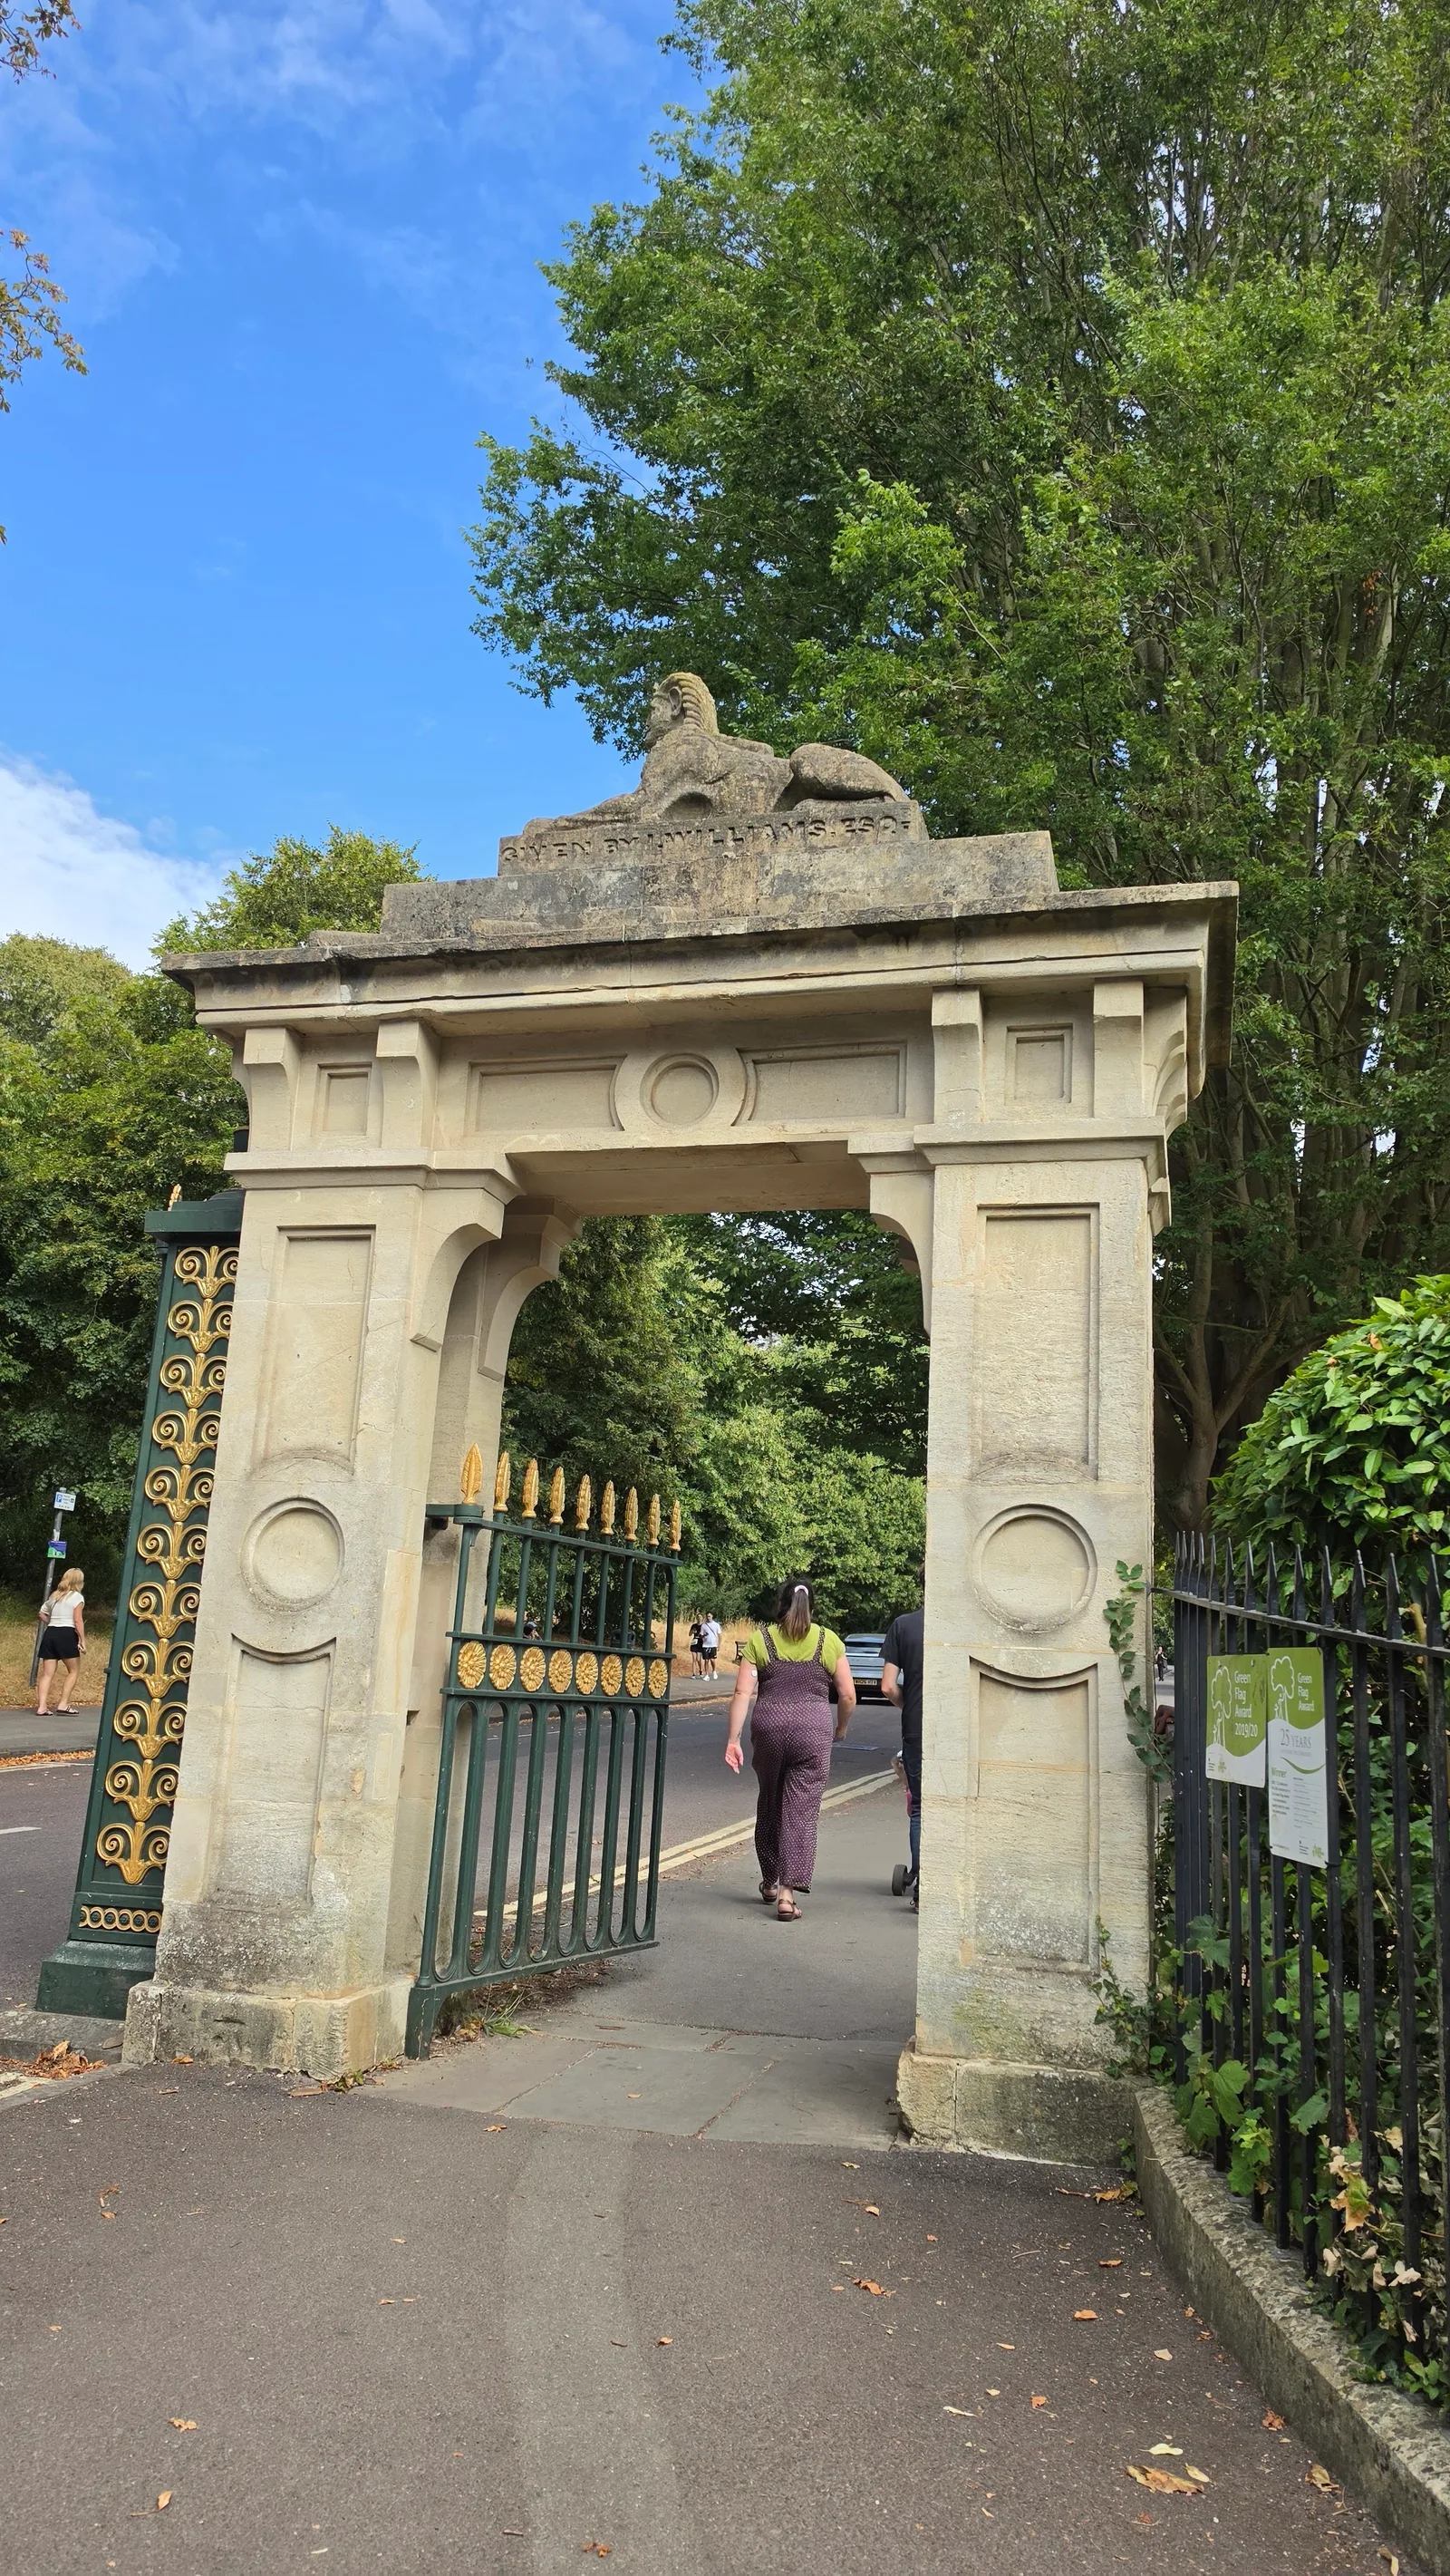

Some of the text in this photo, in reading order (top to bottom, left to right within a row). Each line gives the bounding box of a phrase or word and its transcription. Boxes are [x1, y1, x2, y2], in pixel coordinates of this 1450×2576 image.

[501, 840, 592, 861] GIVEN
[604, 837, 640, 854] BY
[1234, 1671, 1251, 1684] Green
[1297, 1672, 1312, 1684] Green
[1234, 1687, 1246, 1704] Flag
[1298, 1686, 1309, 1700] Flag
[1234, 1704, 1252, 1719] Award
[1298, 1700, 1315, 1712] Award
[1234, 1722, 1258, 1738] 2019/20
[1280, 1729, 1311, 1749] 25 YEARS
[1271, 1767, 1288, 1778] Winner
